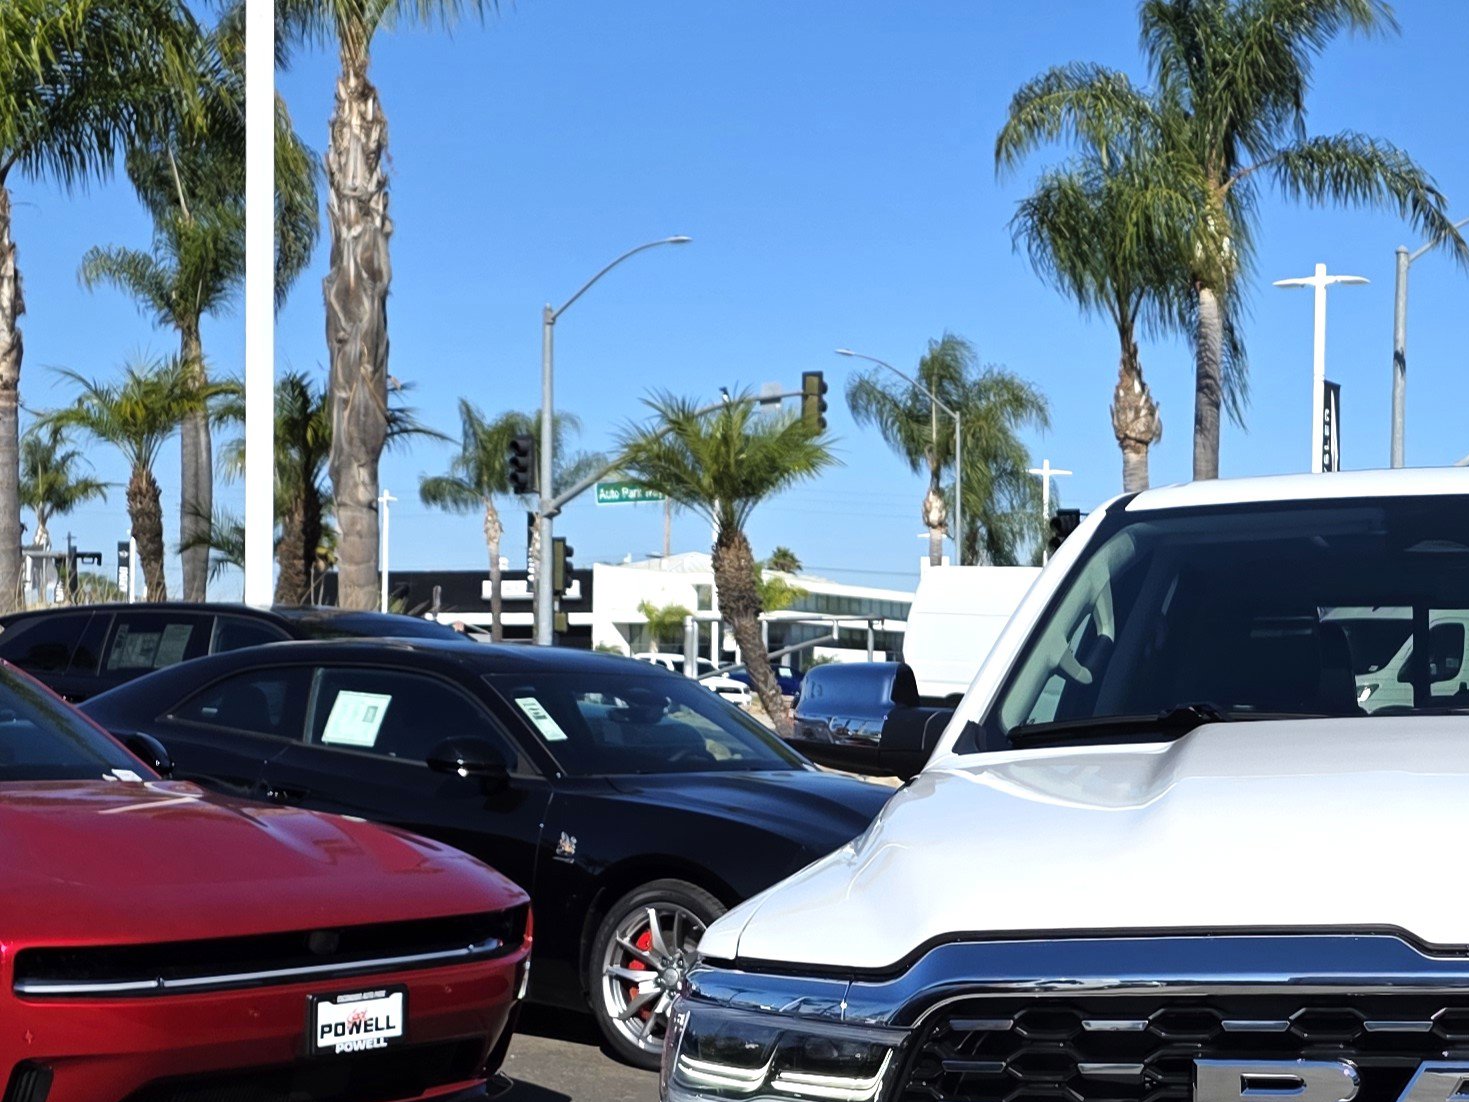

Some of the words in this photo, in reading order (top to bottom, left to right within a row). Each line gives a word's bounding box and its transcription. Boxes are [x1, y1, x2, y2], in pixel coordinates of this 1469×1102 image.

[599, 488, 620, 500] Auto
[621, 487, 642, 499] Park
[320, 1015, 396, 1039] POWELL
[335, 1036, 388, 1055] POWELL
